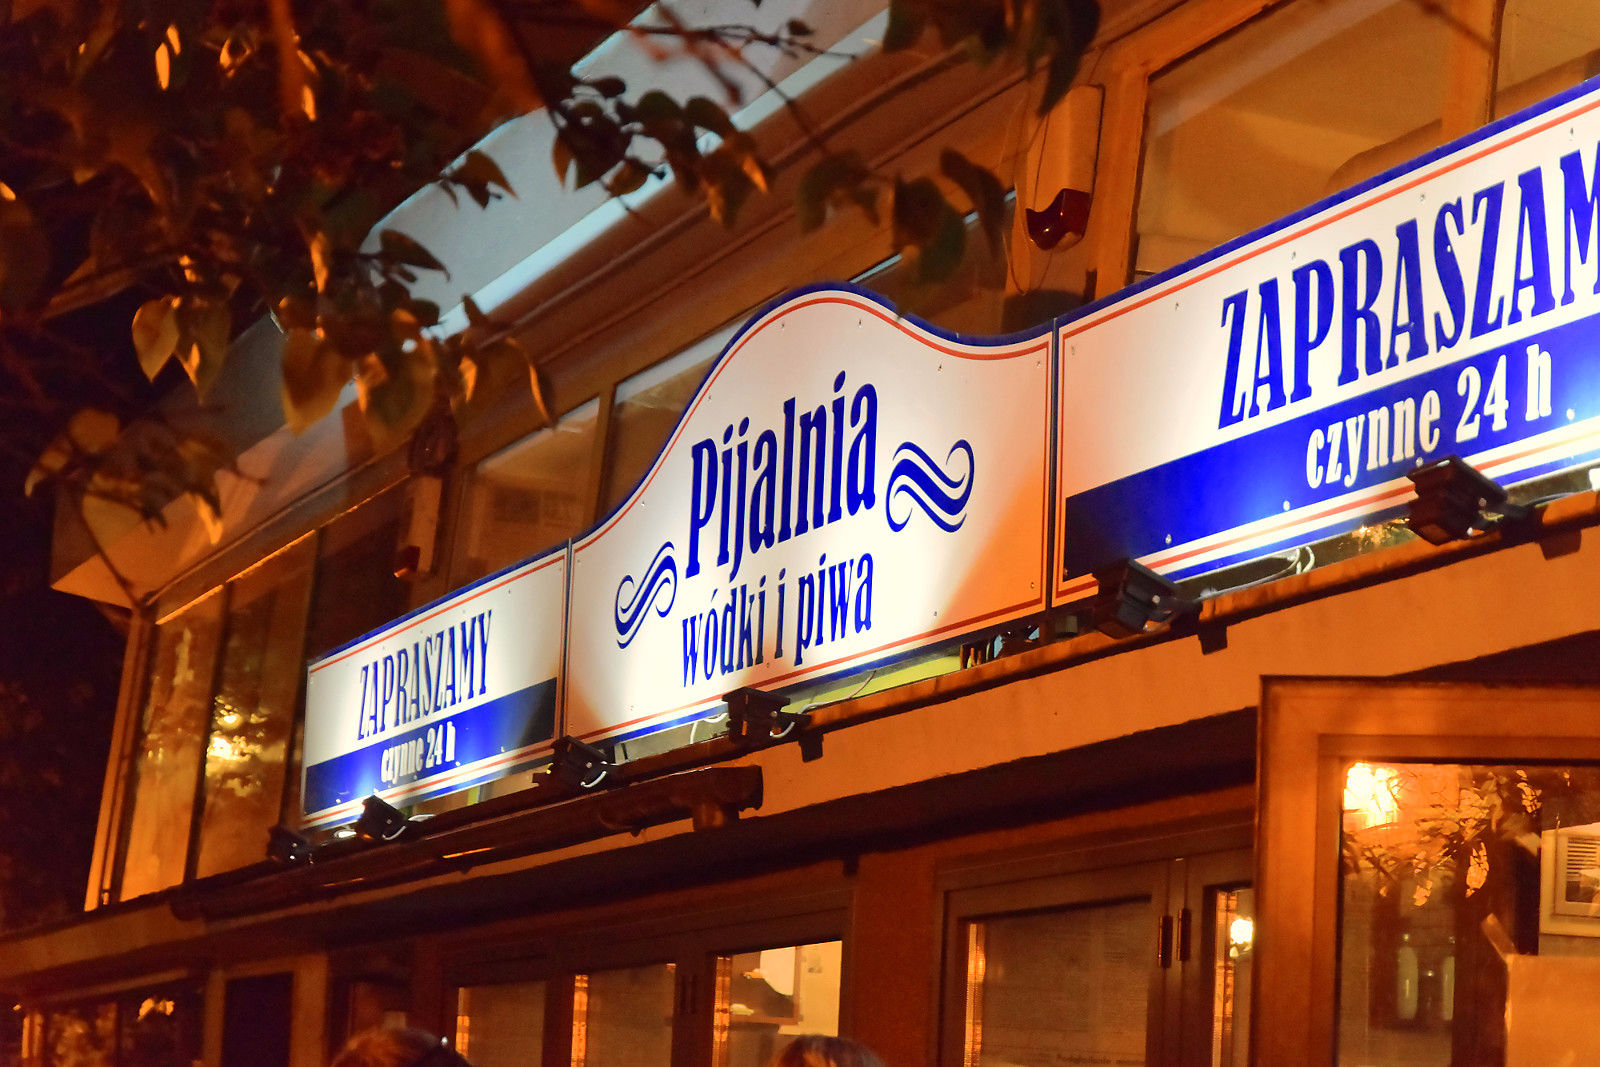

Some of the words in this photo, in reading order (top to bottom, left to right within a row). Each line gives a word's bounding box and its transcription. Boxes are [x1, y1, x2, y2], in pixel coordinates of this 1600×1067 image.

[685, 370, 878, 583] Pijalnia
[1305, 388, 1441, 490] czynne
[1455, 353, 1508, 444] 24
[1525, 343, 1552, 422] h
[357, 609, 492, 741] ZAPRASZAMY
[682, 574, 766, 688] wódki
[774, 567, 786, 659] i
[794, 553, 873, 666] piwa
[381, 738, 424, 785] czynne
[425, 724, 443, 769] 24
[445, 721, 456, 762] h
